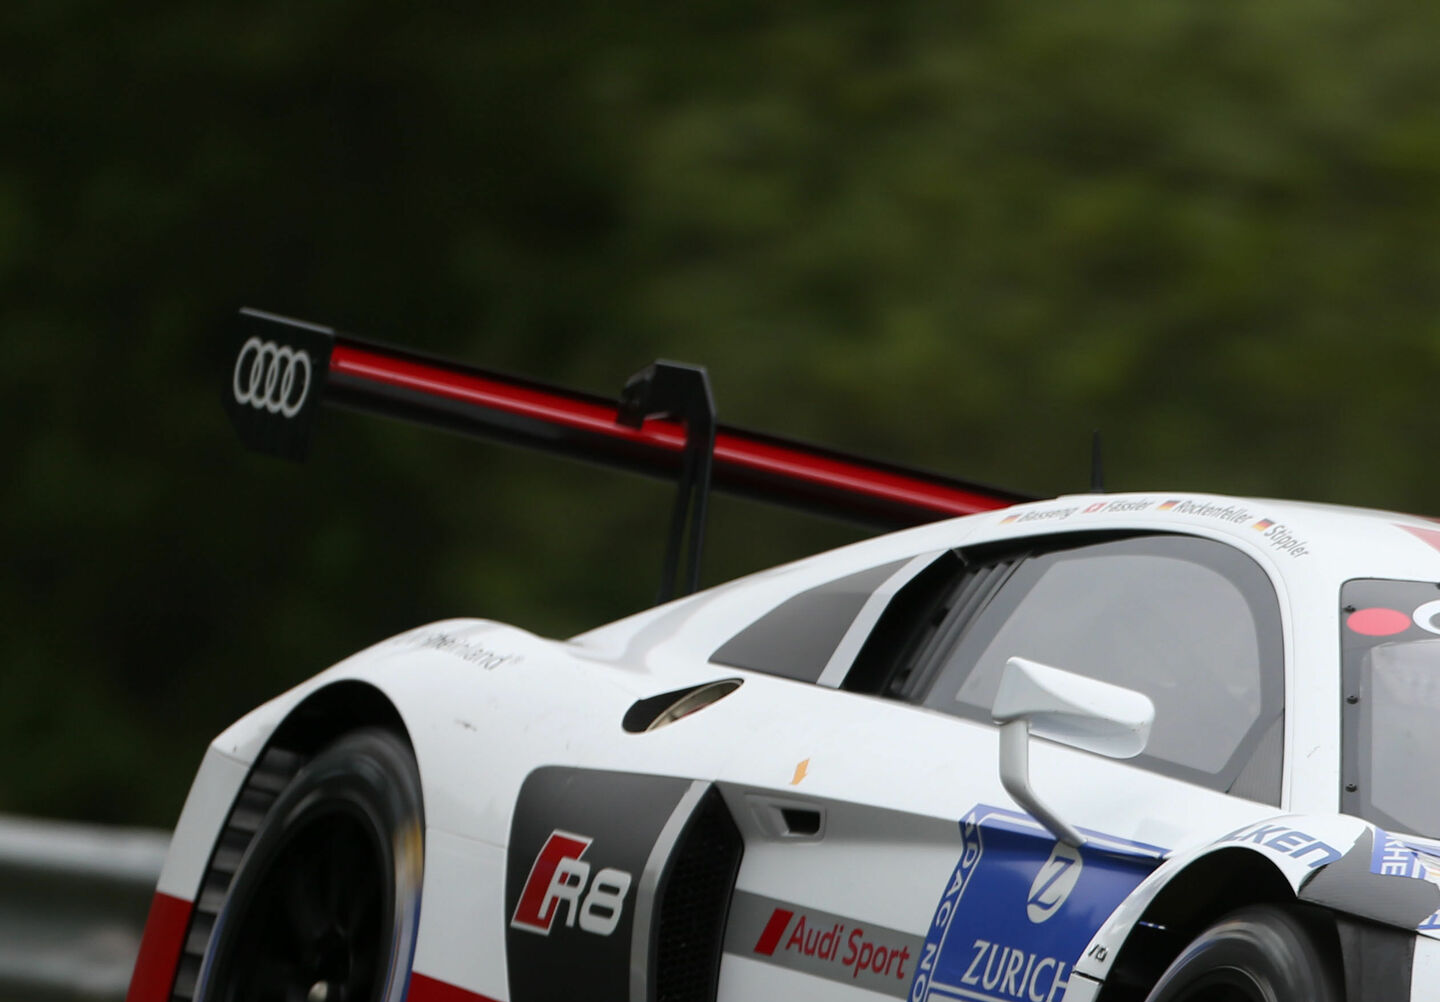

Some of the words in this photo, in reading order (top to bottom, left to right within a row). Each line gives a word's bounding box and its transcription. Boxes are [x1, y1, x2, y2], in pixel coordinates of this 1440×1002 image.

[1175, 499, 1254, 525] Rockenfeller
[1262, 524, 1310, 559] Stippler
[537, 857, 632, 936] R8
[934, 812, 978, 928] ADAC
[785, 915, 845, 959] Audi
[842, 927, 910, 979] Sport
